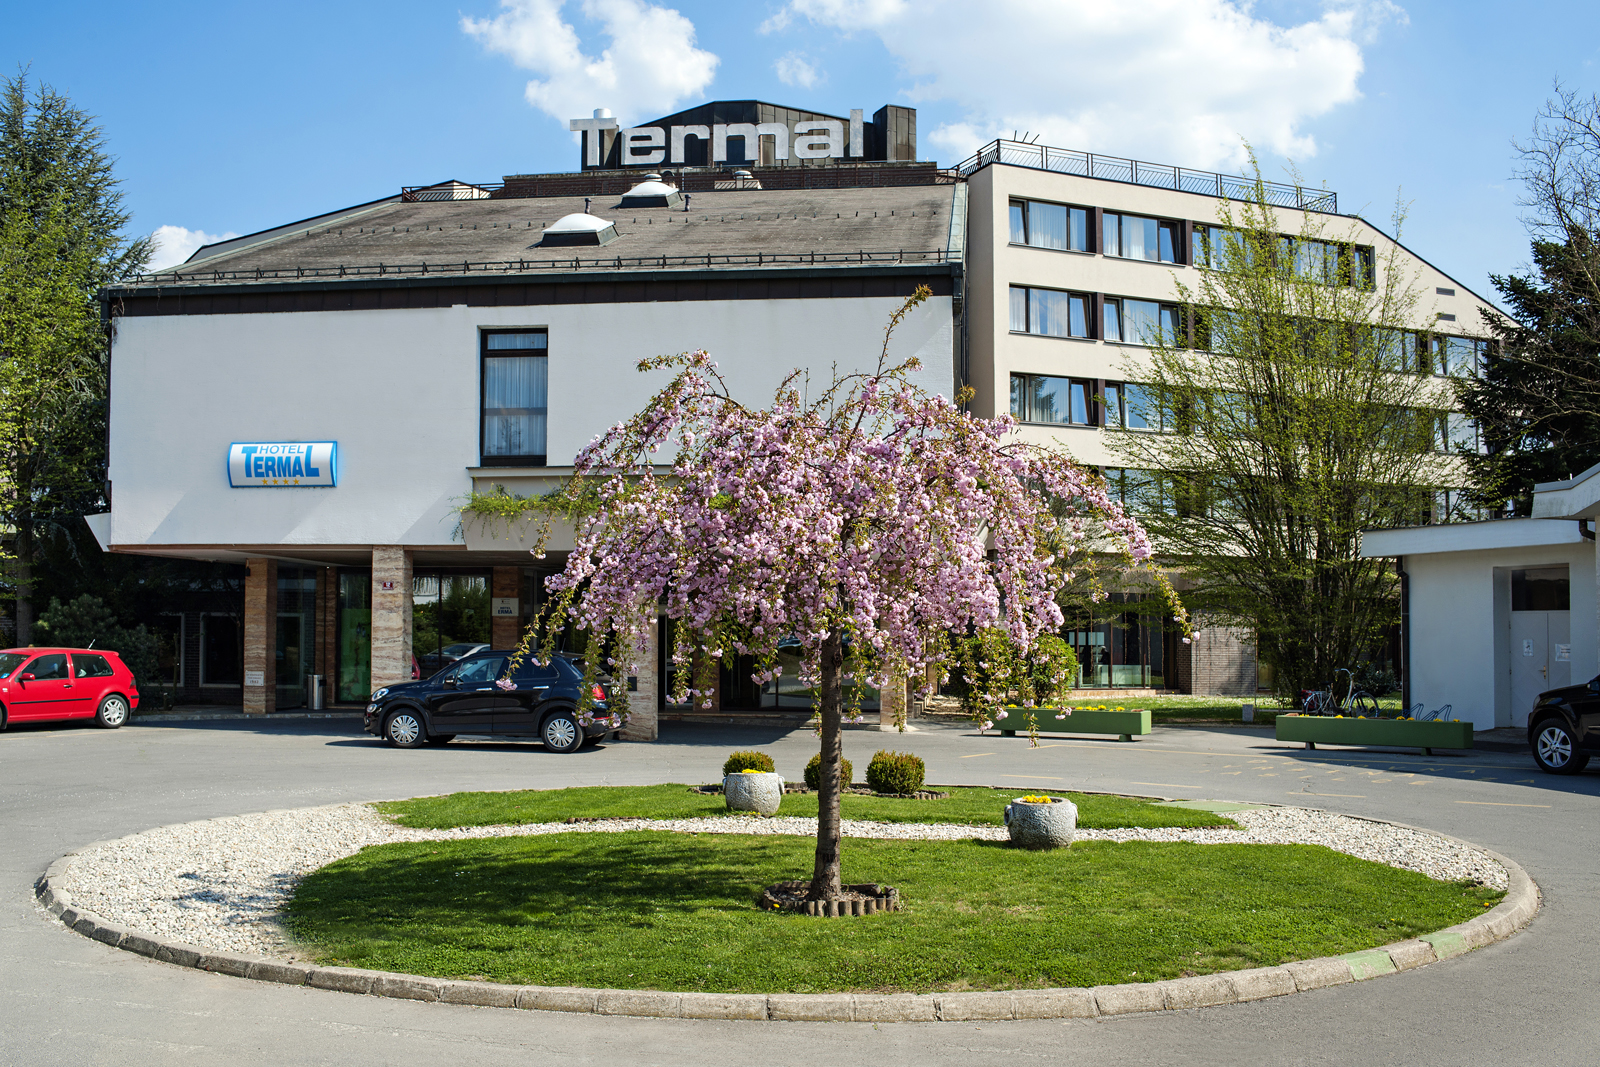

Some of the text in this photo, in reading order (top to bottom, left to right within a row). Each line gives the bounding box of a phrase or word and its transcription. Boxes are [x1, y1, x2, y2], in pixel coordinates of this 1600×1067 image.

[570, 109, 864, 166] Termal
[241, 445, 319, 477] TERMAL
[260, 445, 304, 454] HOTEL
